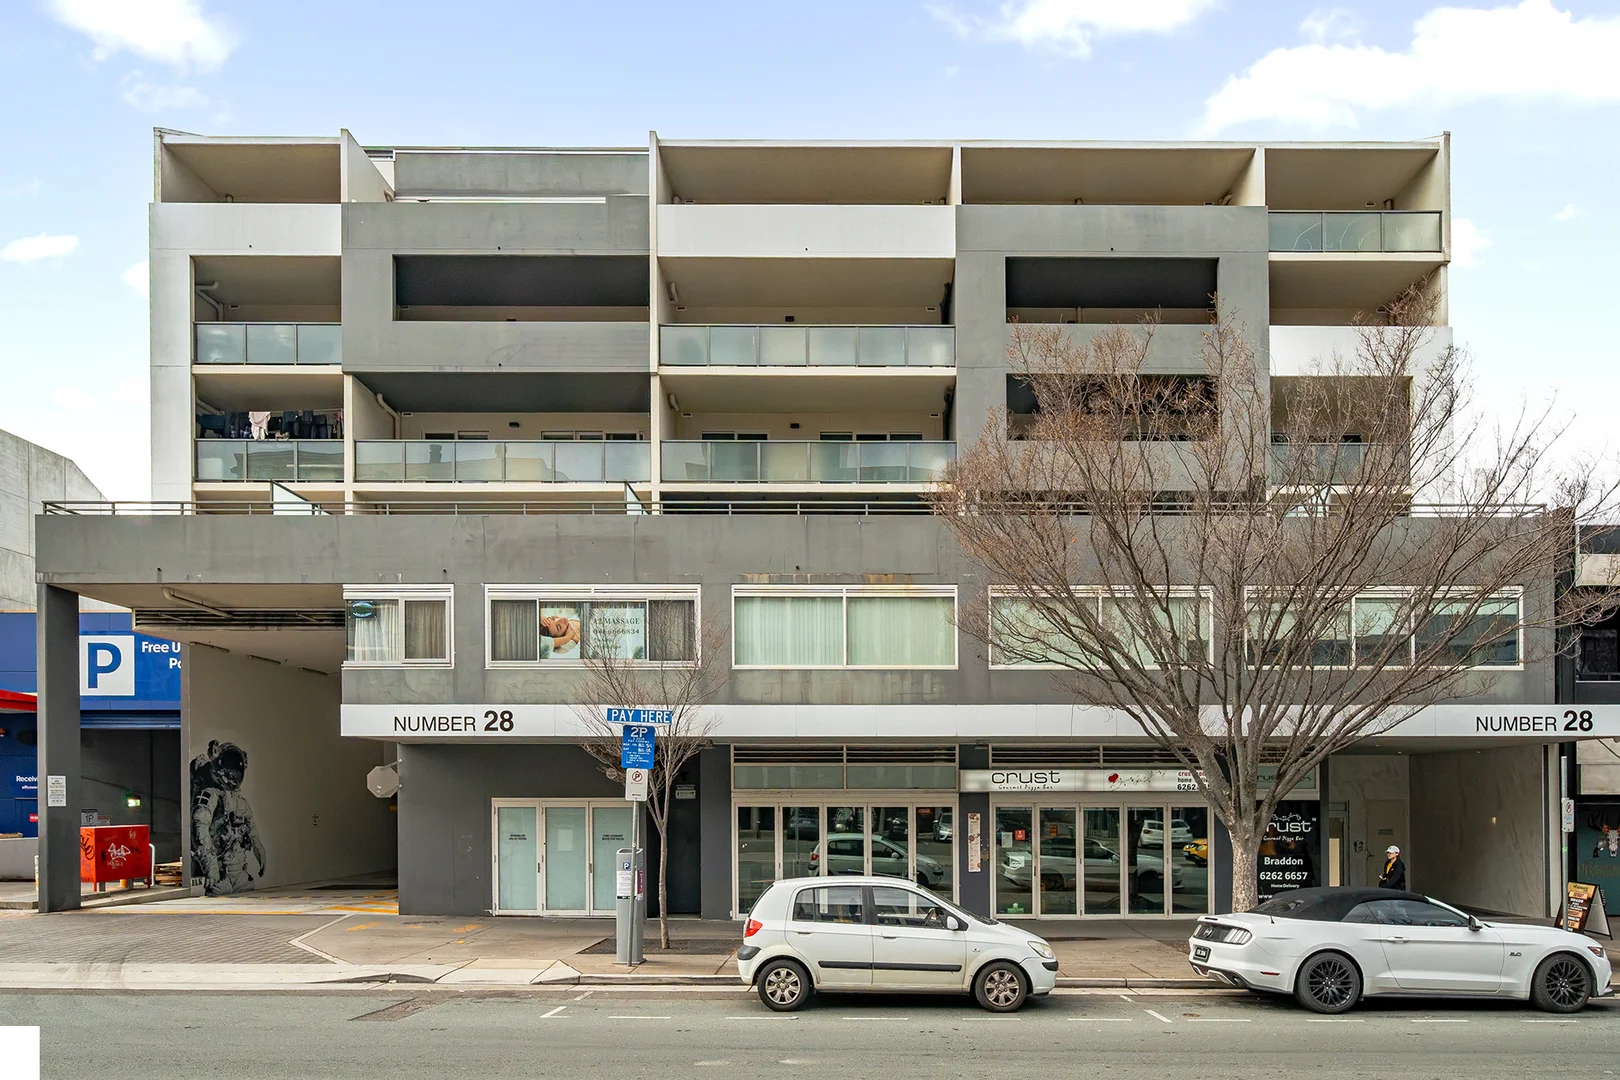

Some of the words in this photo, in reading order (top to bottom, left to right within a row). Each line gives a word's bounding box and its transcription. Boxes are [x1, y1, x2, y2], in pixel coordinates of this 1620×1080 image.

[603, 617, 640, 625] MASSAGE
[141, 641, 169, 653] Free
[88, 643, 122, 688] P
[394, 716, 476, 731] NUMBER
[484, 710, 514, 732] 28
[611, 709, 634, 722] PAY
[640, 710, 671, 723] HERE
[1476, 716, 1557, 732] NUMBER
[1563, 710, 1593, 732] 28
[630, 726, 648, 738] 2P
[991, 770, 1060, 784] crust
[1266, 820, 1311, 833] rust
[1264, 857, 1303, 866] Braddon
[1260, 871, 1283, 880] 6262
[1284, 871, 1308, 880] 6657
